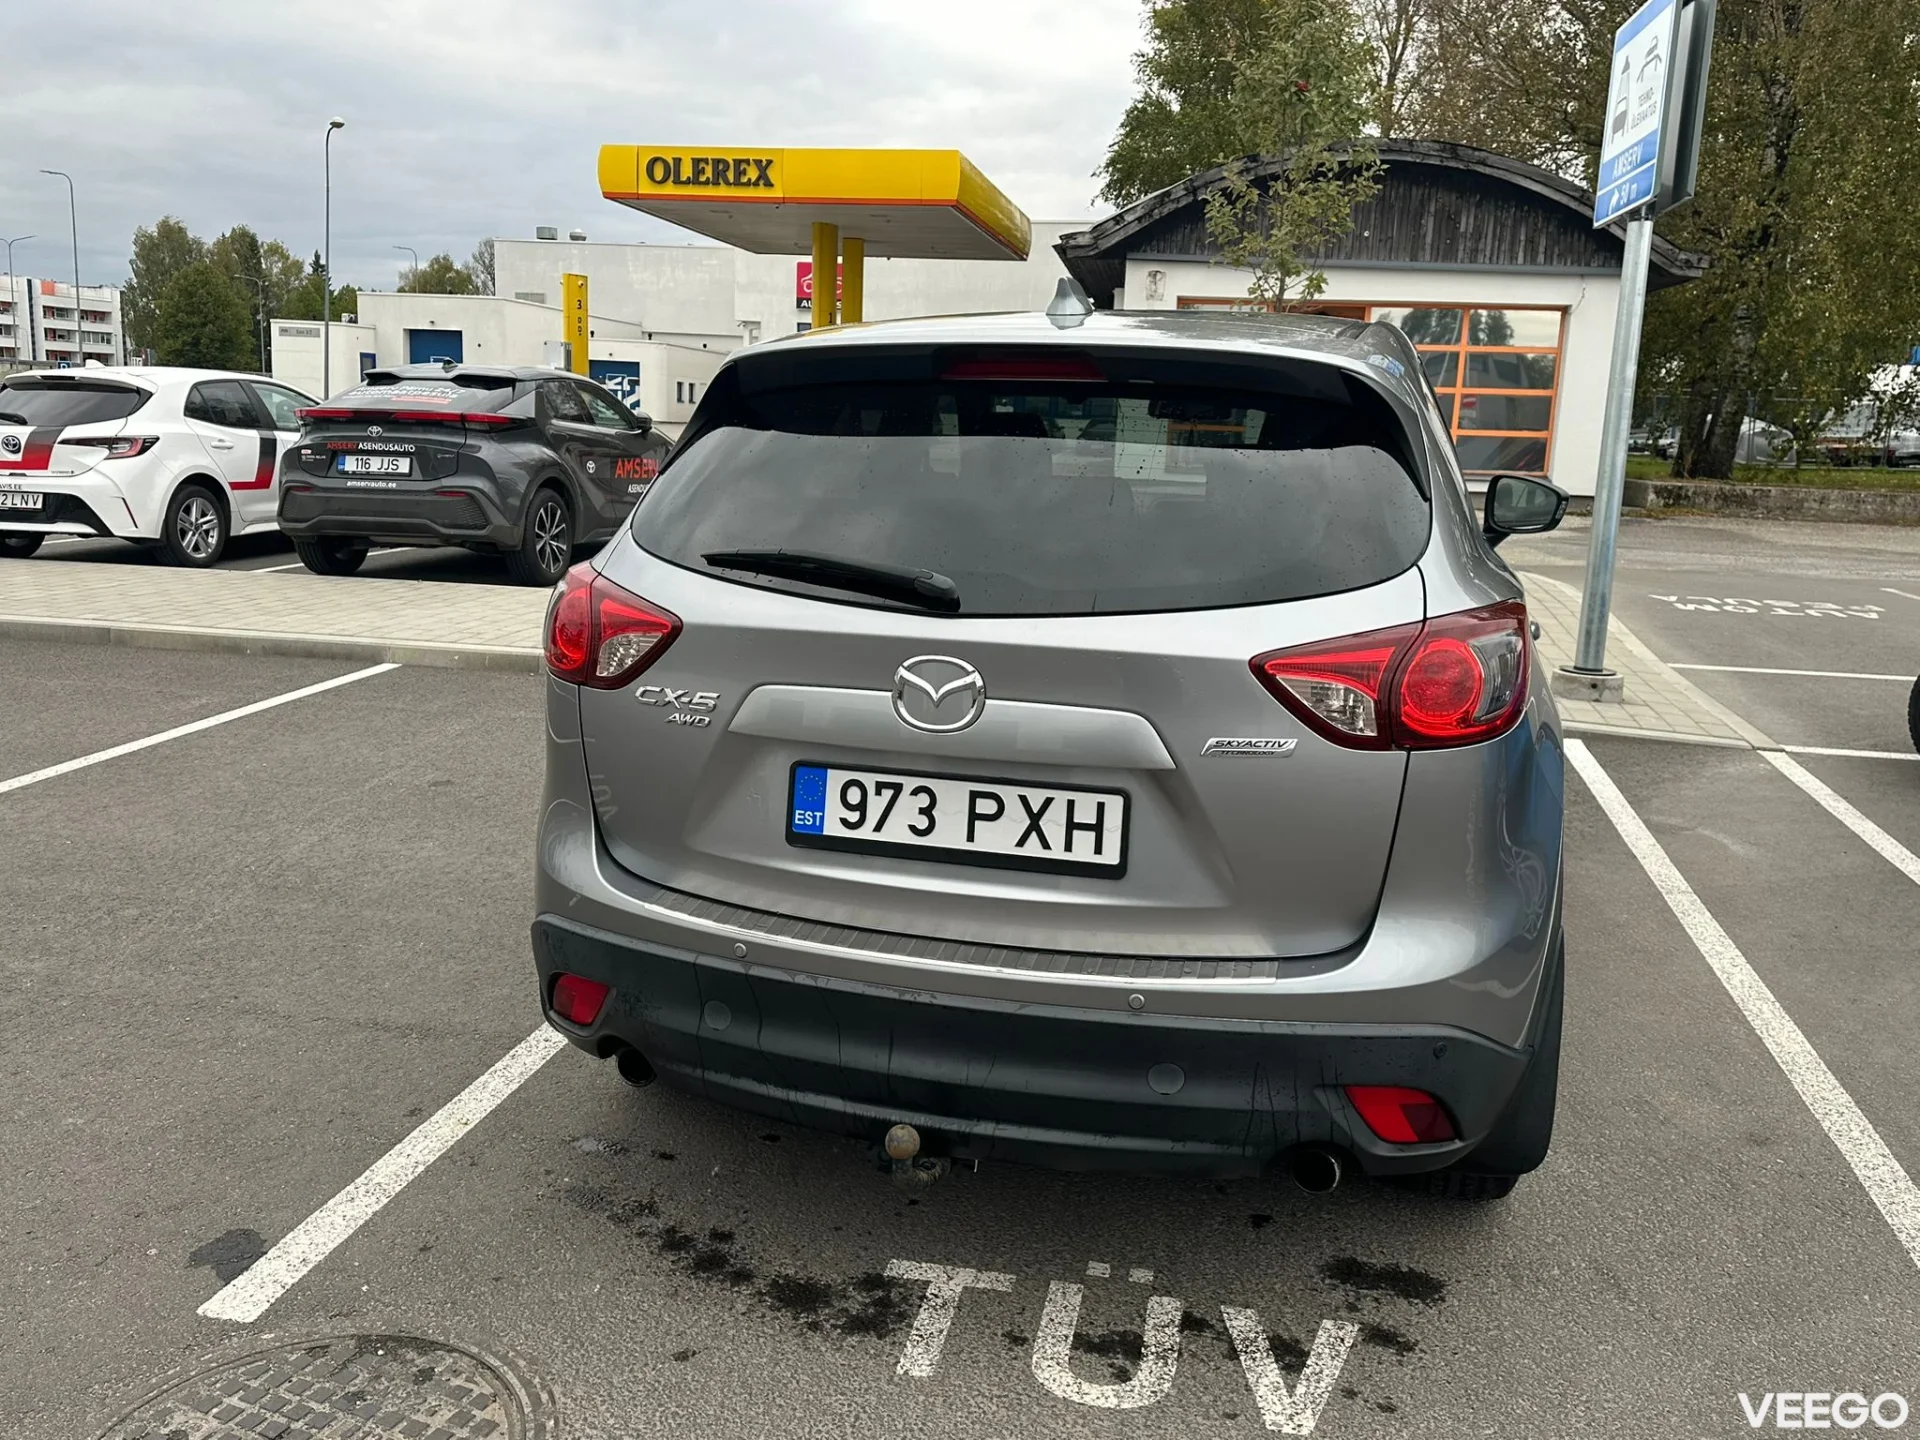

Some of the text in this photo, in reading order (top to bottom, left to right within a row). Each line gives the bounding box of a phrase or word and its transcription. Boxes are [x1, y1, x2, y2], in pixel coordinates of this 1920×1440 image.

[1613, 144, 1642, 177] AMSERV
[645, 156, 775, 188] OLEREX
[576, 299, 583, 310] 3
[326, 442, 416, 452] AMSERV ASENDUSAUTO
[355, 457, 371, 470] 116
[377, 458, 400, 471] JJS
[346, 480, 397, 488] amservauto.ee
[634, 686, 721, 713] CX-5
[665, 713, 711, 728] AWD
[1213, 740, 1289, 748] SKYACTIV
[794, 810, 823, 827] EST
[838, 778, 1106, 856] 973 PXH
[884, 1259, 1361, 1435] TÜV
